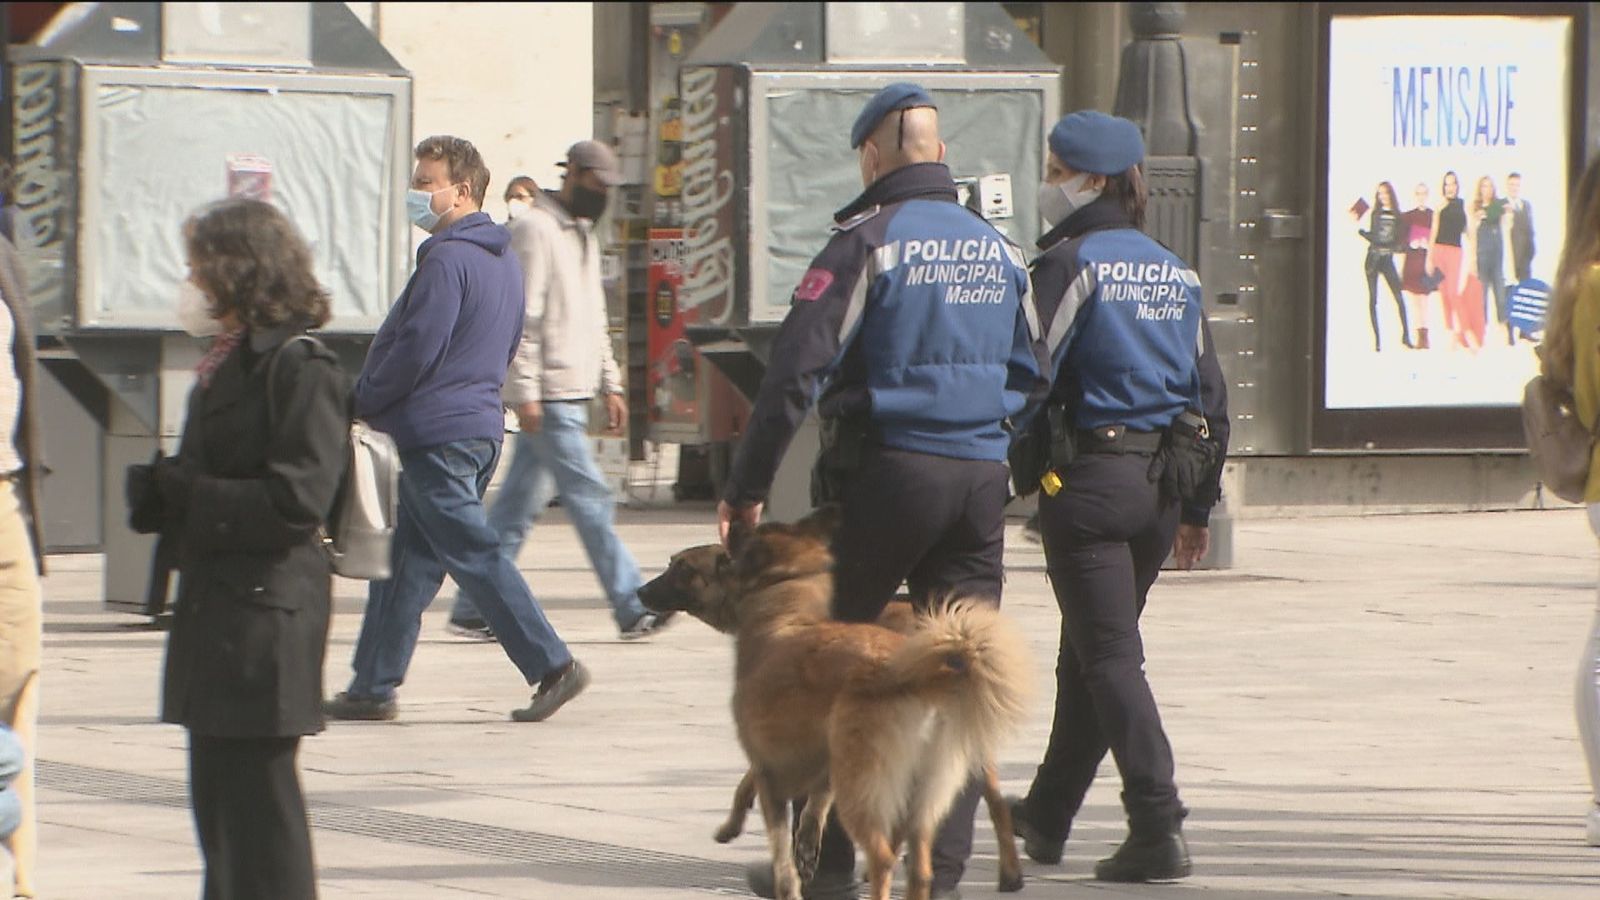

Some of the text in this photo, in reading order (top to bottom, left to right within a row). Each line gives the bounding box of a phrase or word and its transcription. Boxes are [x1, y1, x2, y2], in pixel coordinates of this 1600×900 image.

[1393, 65, 1518, 147] MENSAJE
[903, 235, 1002, 264] POLICÍA
[906, 263, 1008, 286] MUNICIPAL
[1097, 260, 1182, 283] POLICÍA
[945, 284, 1006, 305] Madrid
[1101, 283, 1188, 303] MUNICIPAL
[1136, 302, 1186, 321] Madrid
